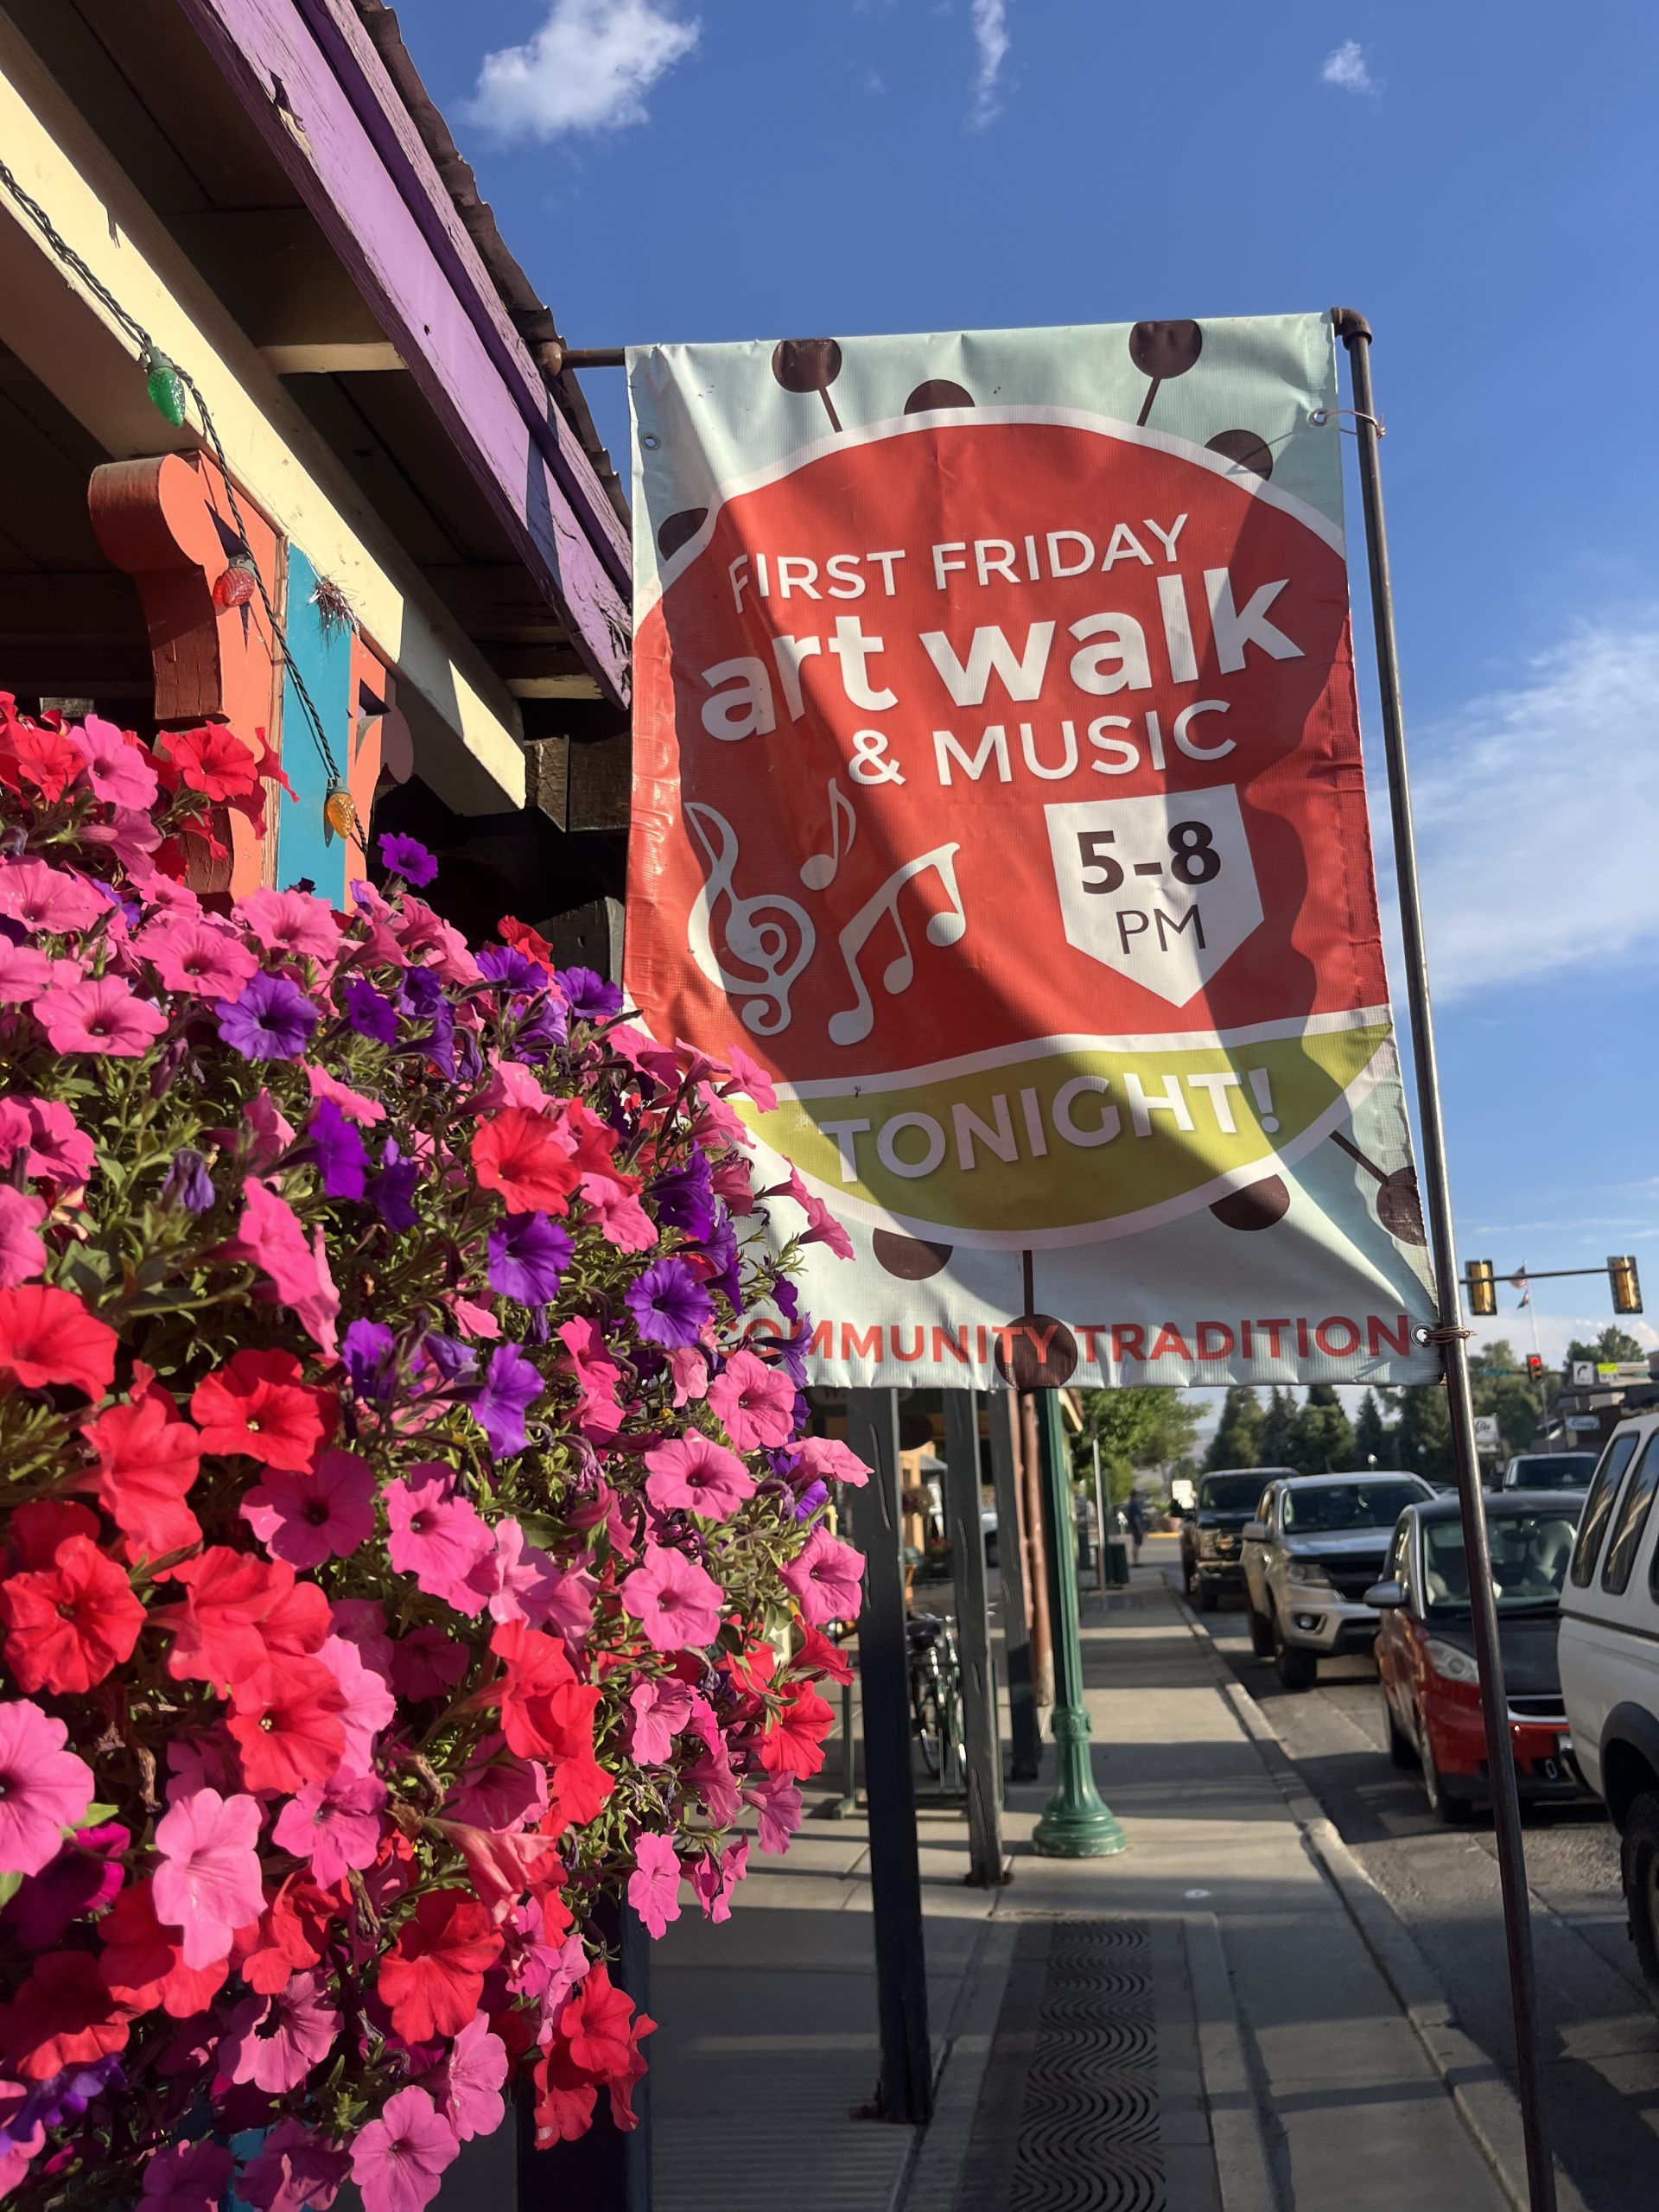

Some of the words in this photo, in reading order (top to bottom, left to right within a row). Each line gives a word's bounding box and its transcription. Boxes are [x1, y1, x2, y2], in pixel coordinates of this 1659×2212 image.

[728, 550, 906, 614] FIRST
[932, 513, 1189, 591] FRIDAY
[700, 615, 899, 741] art
[919, 567, 1306, 707] walk
[848, 729, 906, 786] &
[932, 700, 1237, 787] MUSIC
[1077, 821, 1221, 894] 5-8
[1116, 904, 1206, 955] PM
[817, 1067, 1281, 1183] TONIGHT!
[1074, 1314, 1411, 1363] TRADITION
